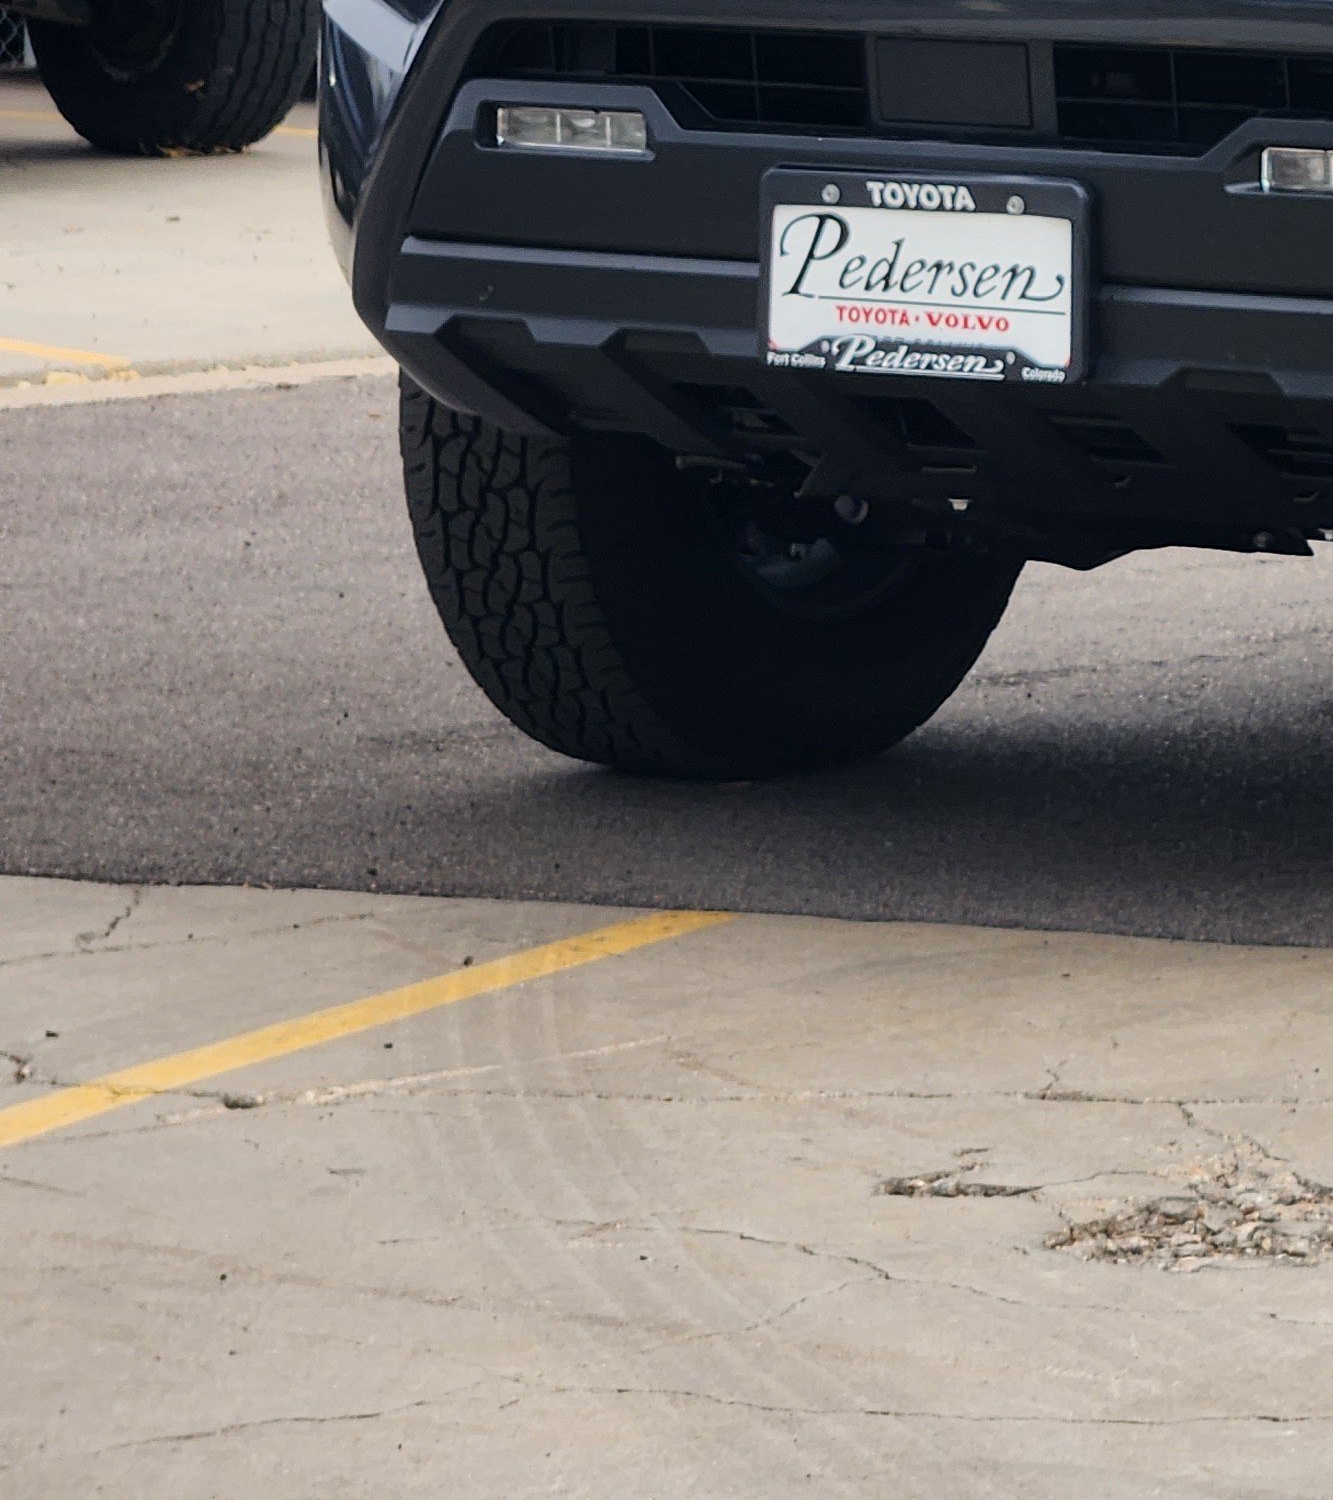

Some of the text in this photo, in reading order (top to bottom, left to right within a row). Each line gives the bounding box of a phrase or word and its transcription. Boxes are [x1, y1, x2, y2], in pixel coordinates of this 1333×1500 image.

[866, 181, 976, 211] TOYOTA
[780, 212, 1066, 301] Pedersen
[835, 305, 1010, 333] TOYOTA VOLVO
[831, 333, 1005, 374] Pedersen
